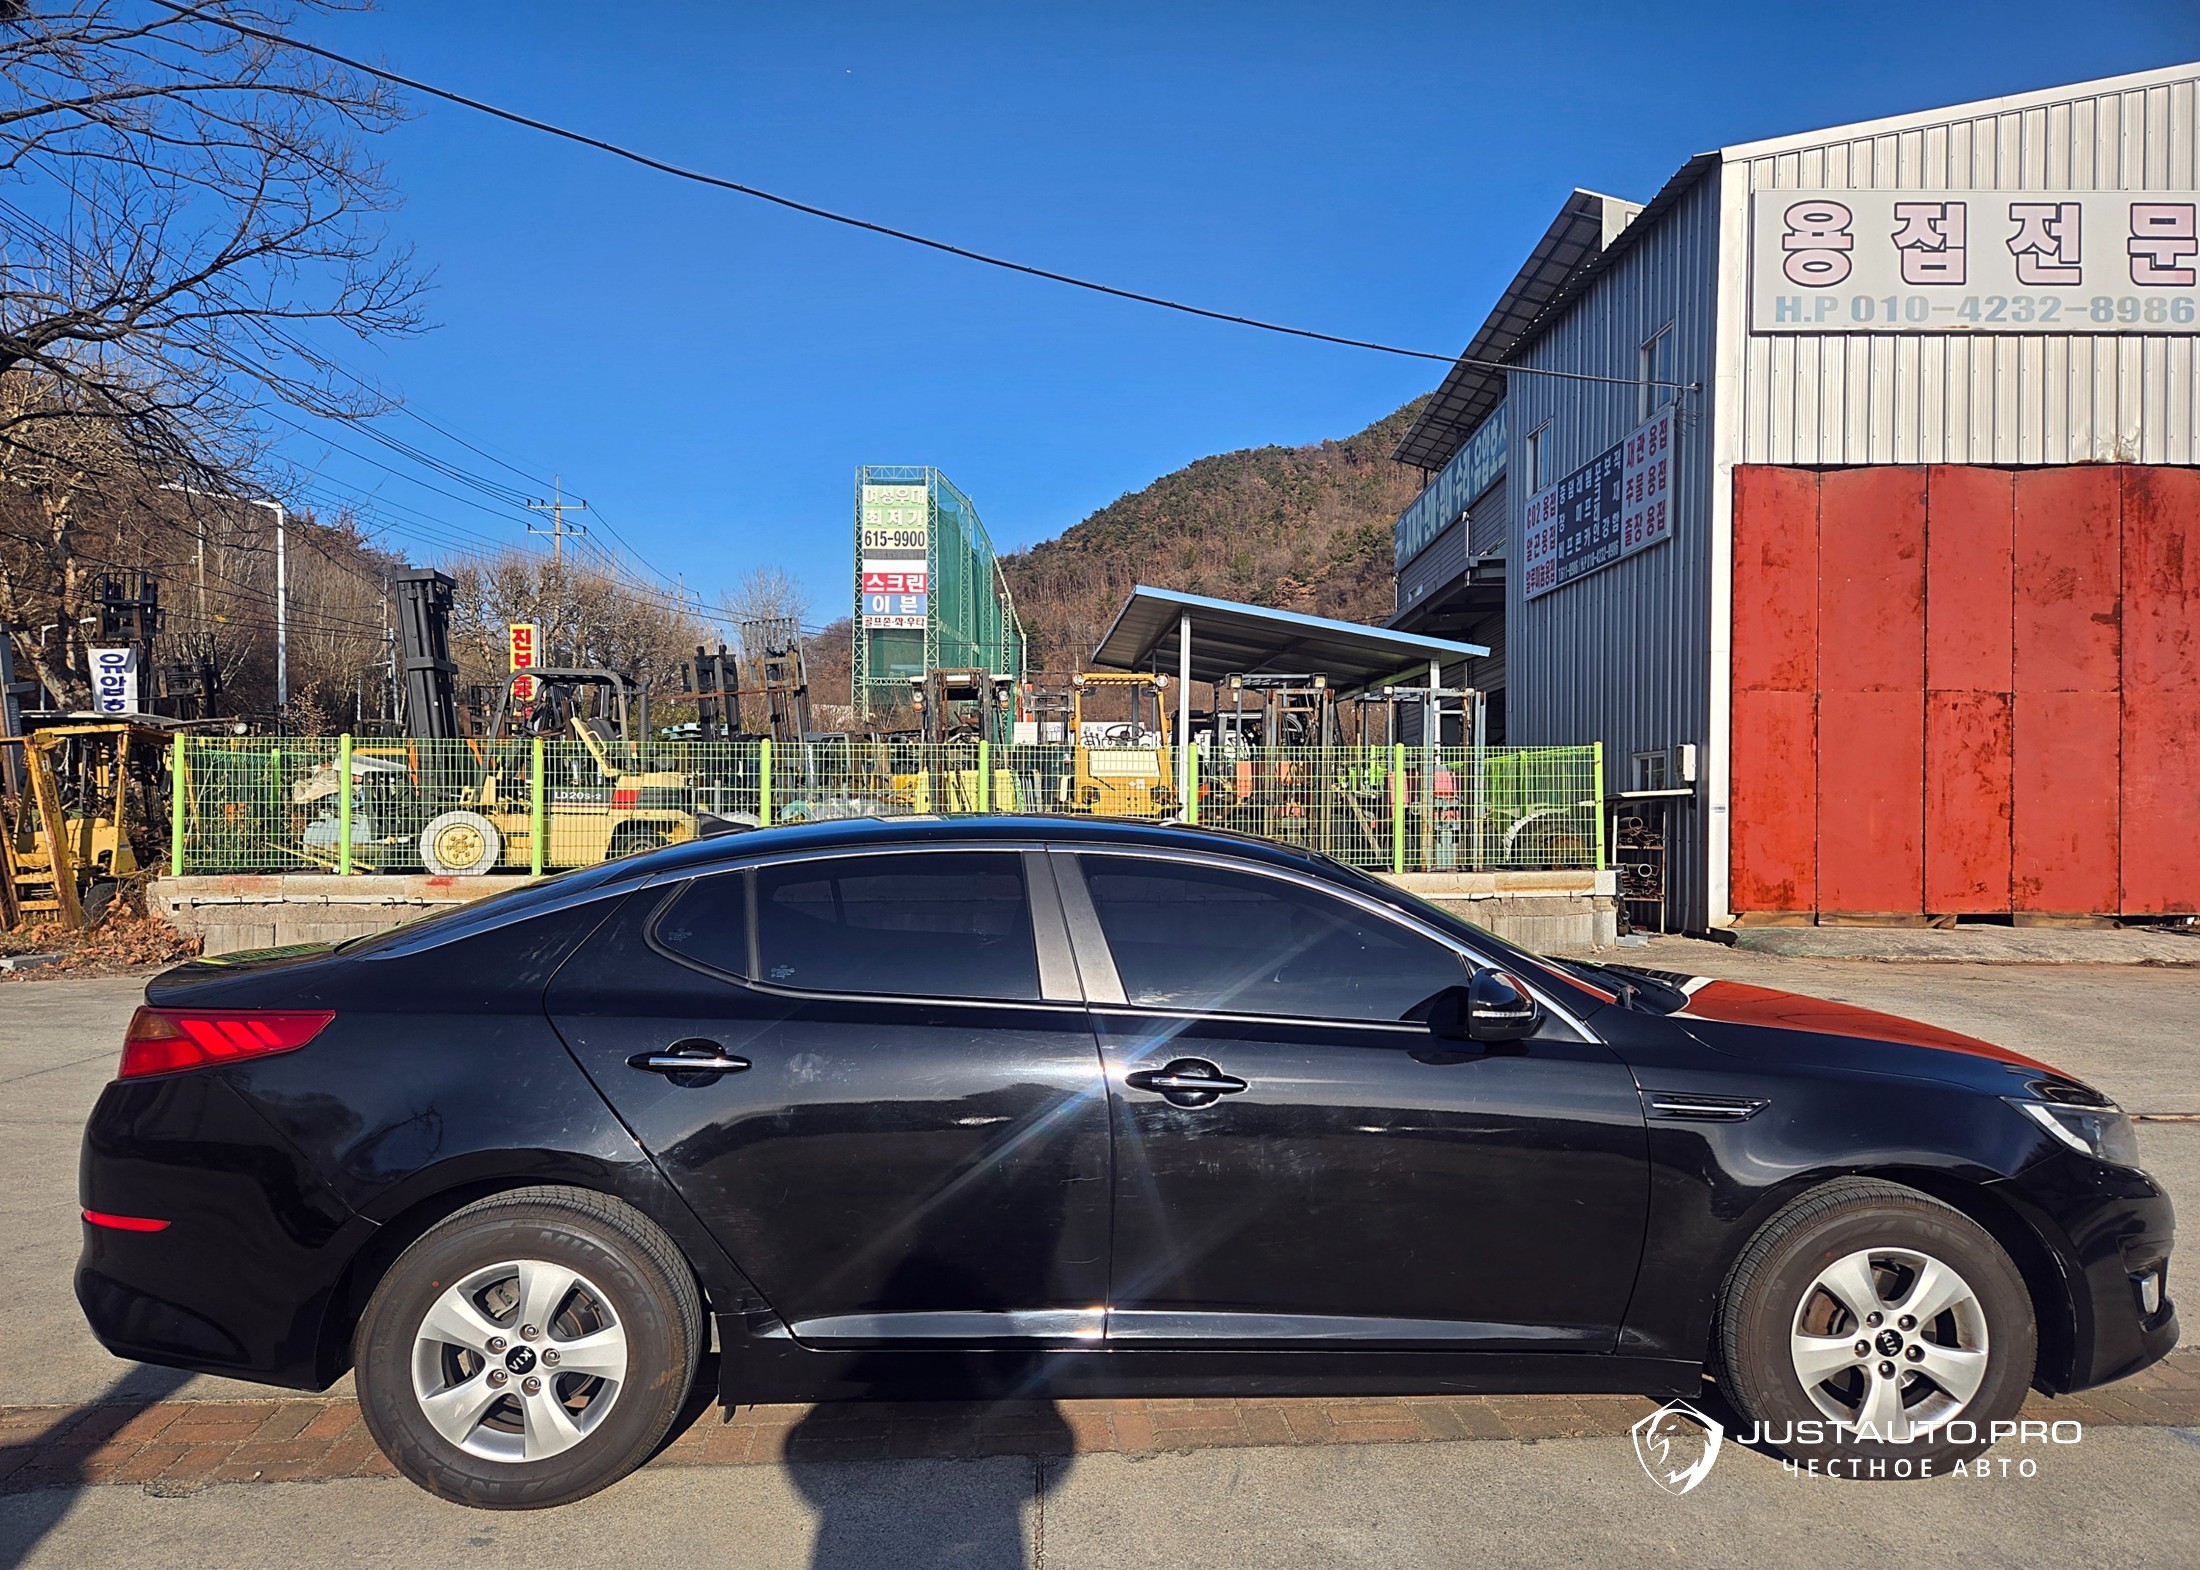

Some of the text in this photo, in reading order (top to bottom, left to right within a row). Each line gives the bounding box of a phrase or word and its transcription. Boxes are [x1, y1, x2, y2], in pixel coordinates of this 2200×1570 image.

[1774, 295, 2196, 323] H.P 010-4232-8986
[1648, 416, 1668, 457] 용접
[1647, 457, 1667, 497] 용접
[865, 487, 925, 505] 여성우대
[1542, 490, 1557, 522] 용접
[1646, 498, 1666, 537] 용접
[864, 530, 925, 547] 615-9900
[866, 574, 925, 593] 스크린
[1881, 1332, 1898, 1356] KIA
[508, 1349, 533, 1371] KIA
